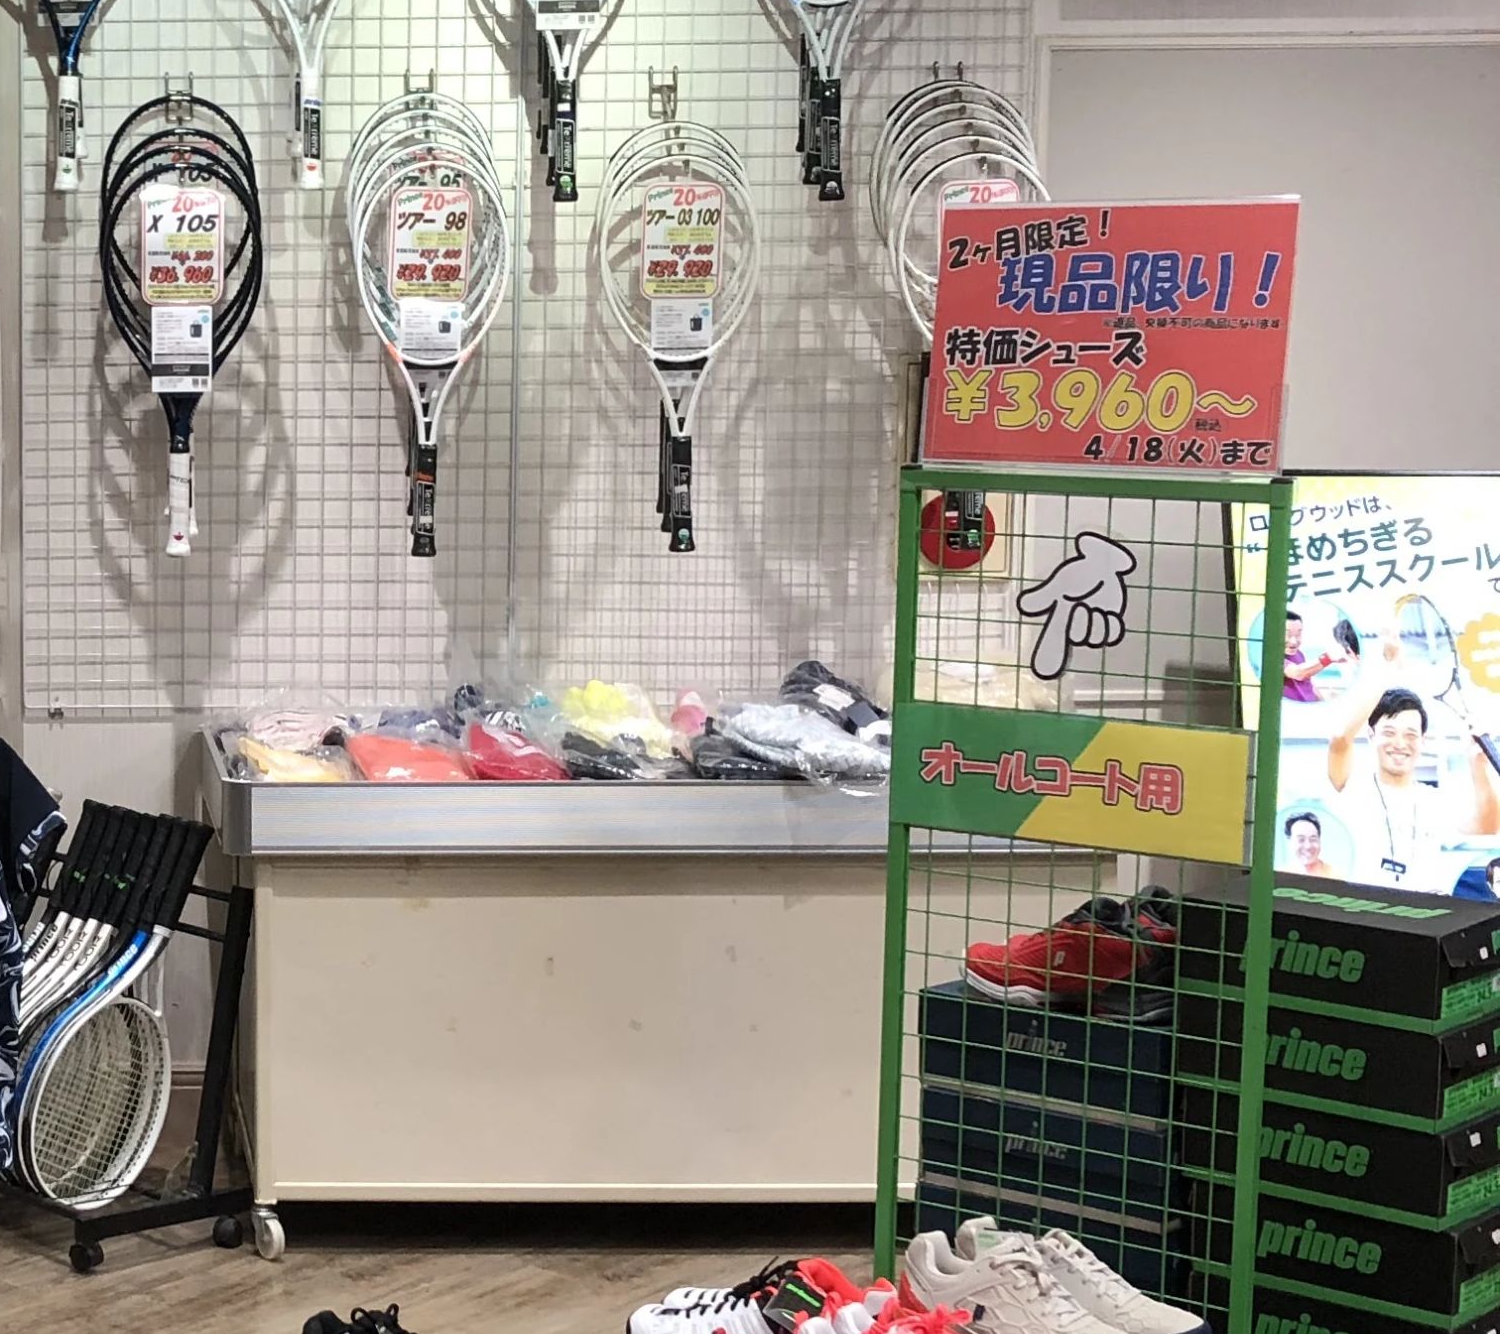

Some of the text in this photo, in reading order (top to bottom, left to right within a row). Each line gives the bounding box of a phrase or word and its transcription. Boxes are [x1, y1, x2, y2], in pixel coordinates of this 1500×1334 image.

[147, 214, 219, 233] X 105
[397, 211, 467, 231] ツアー 98
[646, 208, 721, 226] ツアー 03 100
[945, 328, 1147, 367] 特価シューズ
[919, 741, 1185, 816] オールコート用
[1273, 887, 1453, 920] prince
[1005, 1019, 1068, 1059] prince
[1256, 1218, 1382, 1275] prince
